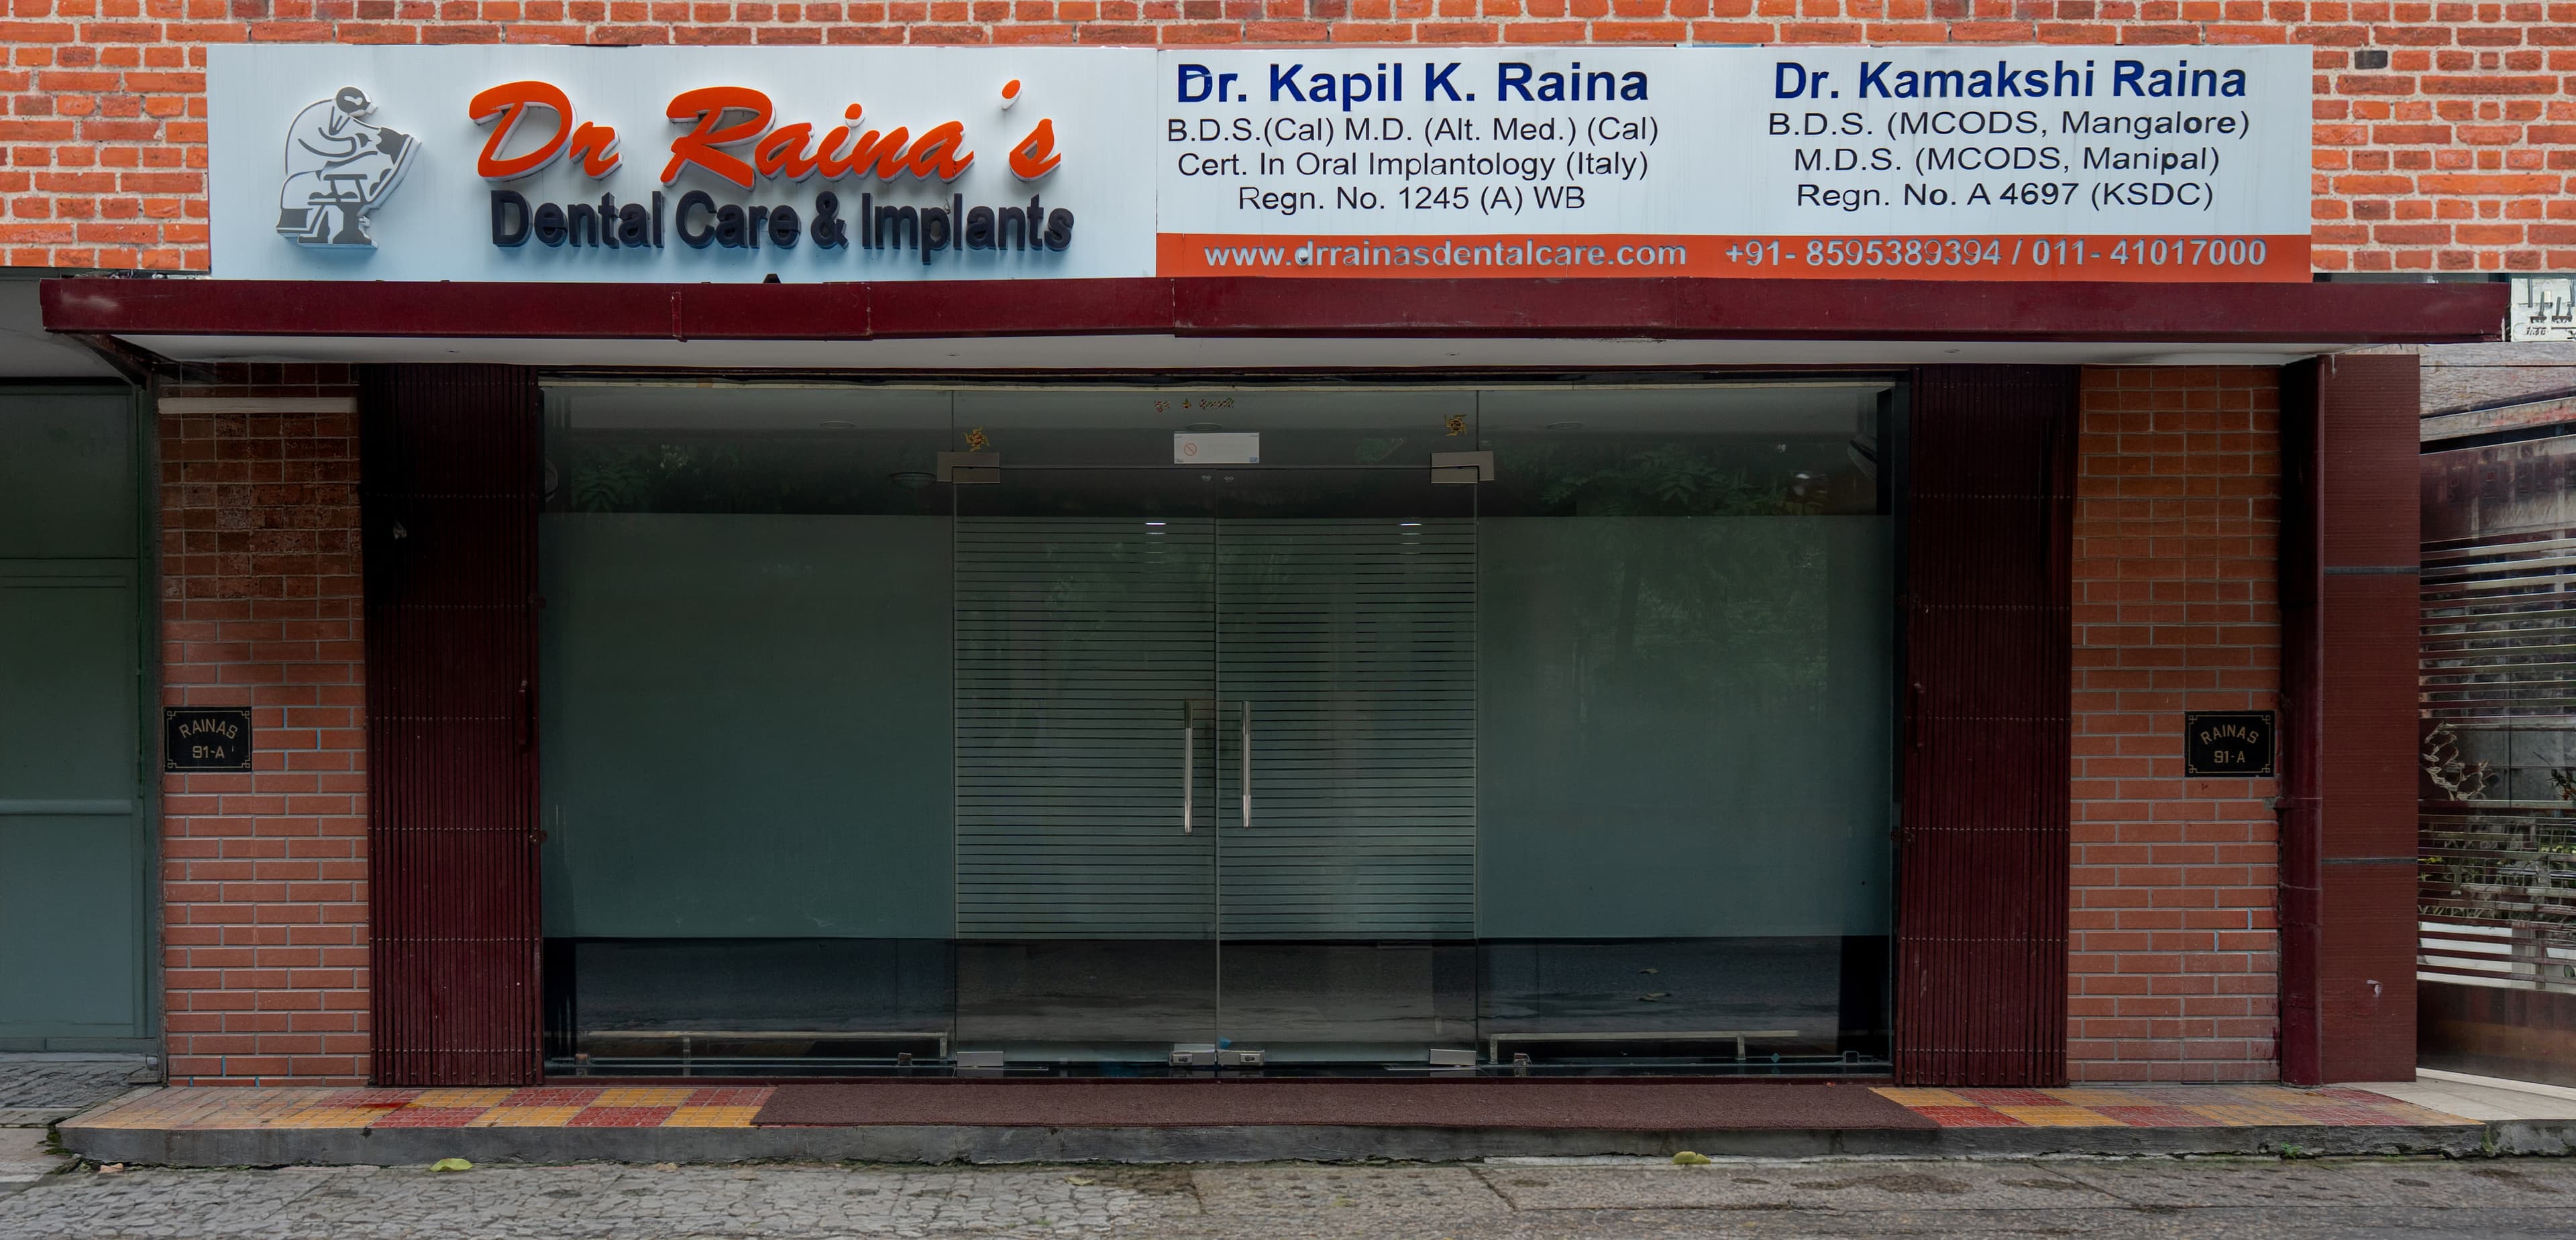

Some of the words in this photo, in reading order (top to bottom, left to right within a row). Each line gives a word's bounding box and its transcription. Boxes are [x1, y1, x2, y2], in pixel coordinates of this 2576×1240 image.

[1178, 64, 1247, 103] Dr.
[1270, 62, 1402, 111] Kapil
[1425, 62, 1475, 102] K.
[1498, 62, 1648, 102] Raina
[1775, 62, 1839, 99] Dr.
[1859, 60, 2094, 99] Kamakshi
[2113, 60, 2246, 97] Raina
[469, 80, 622, 180] Dr
[1168, 117, 1334, 146] B.D.S.(Cal)
[1346, 117, 1411, 141] M.D.
[1425, 117, 1480, 146] (Alt.
[1493, 117, 1576, 146] Med.)
[1588, 116, 1659, 146] (Cal)
[1769, 112, 1872, 135] B.D.S.
[1888, 111, 2047, 141] (MCODS,
[2062, 110, 2250, 140] Mangalore)
[1178, 152, 1247, 176] Cert.
[1260, 152, 1284, 175] In
[1296, 152, 1356, 176] Oral
[1369, 152, 1556, 181] Implantology
[1566, 151, 1648, 181] (Italy)
[1794, 148, 1900, 171] M.D.S.
[1915, 146, 2069, 176] (MCODS,
[2084, 146, 2220, 176] Manipal)
[1239, 186, 1324, 216] Regn.
[1337, 186, 1385, 210] No.
[1399, 186, 1469, 209] 1245
[1481, 186, 1523, 216] (A)
[1534, 186, 1585, 209] WB
[1797, 184, 1889, 212] Regn.
[1904, 183, 1956, 206] No.
[1966, 182, 1992, 205] A
[1999, 182, 2080, 205] 4697
[2091, 182, 2214, 211] (KSDC)
[490, 190, 665, 249] Dental
[675, 190, 802, 250] Care
[810, 190, 849, 250] &
[861, 192, 1075, 266] Implants
[1204, 240, 1686, 266] www.drrainasdentalcare.com
[1725, 241, 1796, 266] +91-
[1806, 240, 2002, 266] 8595389394
[2012, 240, 2023, 265] /
[2033, 240, 2100, 266] 011-
[2110, 239, 2267, 266] 41017000
[178, 718, 238, 740] RAINAS
[2200, 724, 2259, 745] RAINAS
[192, 745, 225, 758] 91-A
[2214, 750, 2246, 763] 91-A
